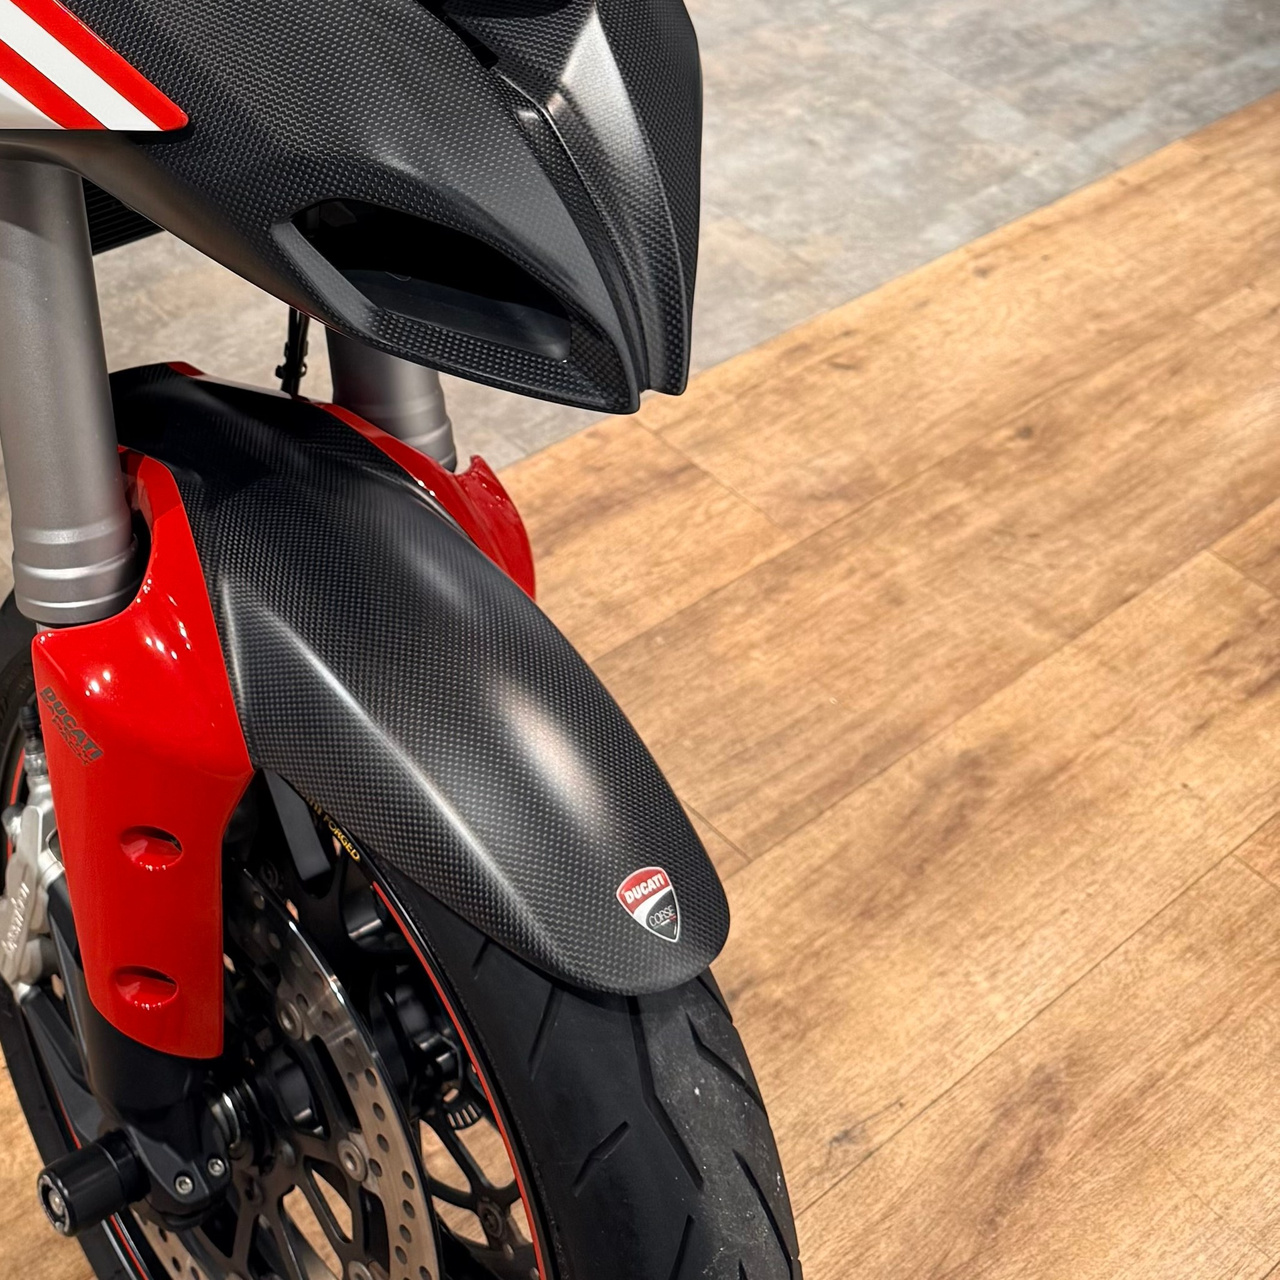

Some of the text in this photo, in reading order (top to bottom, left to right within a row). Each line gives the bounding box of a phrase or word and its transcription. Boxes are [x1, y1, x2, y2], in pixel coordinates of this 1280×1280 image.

[42, 687, 103, 760] DUCATI
[323, 815, 360, 861] FORGED
[623, 873, 666, 904] DUCATI
[648, 904, 675, 927] CORSE
